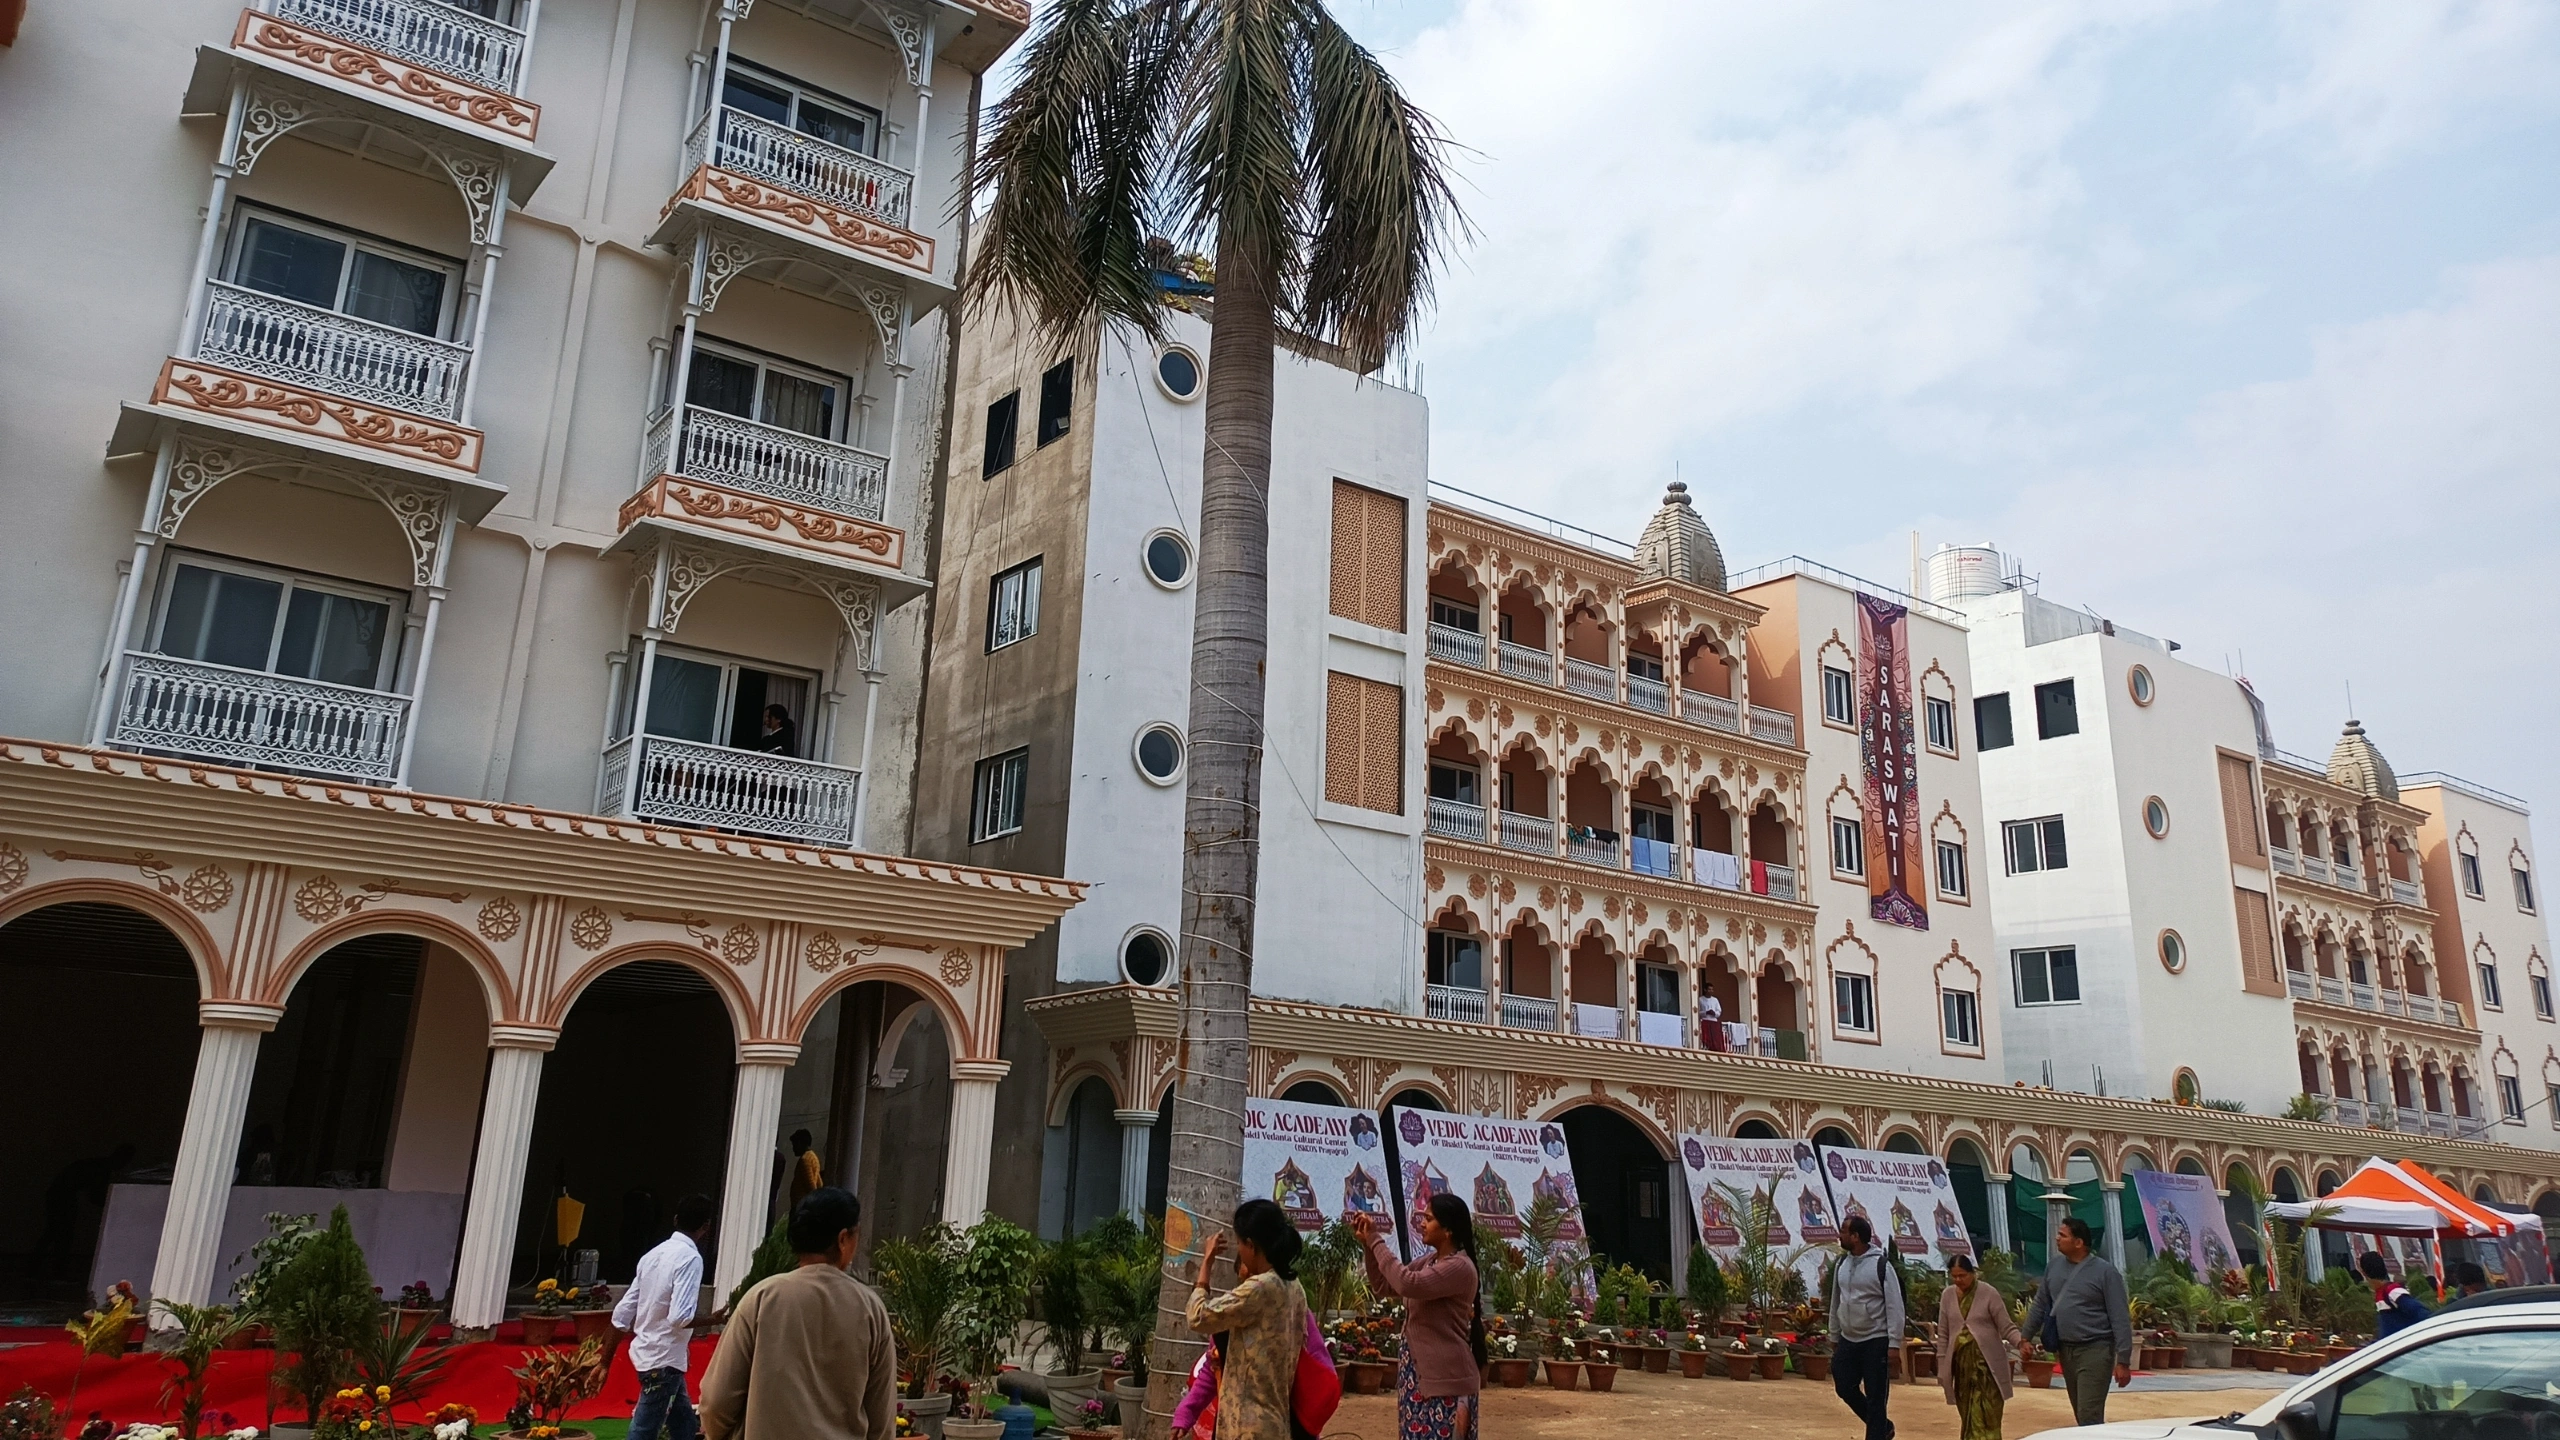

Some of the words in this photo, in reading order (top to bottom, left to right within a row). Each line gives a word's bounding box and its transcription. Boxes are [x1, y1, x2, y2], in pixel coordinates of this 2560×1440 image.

[1879, 666, 1899, 876] SARASWATI
[1245, 1109, 1267, 1129] DIC
[1273, 1112, 1347, 1137] ACADEMY
[1426, 1119, 1468, 1140] VEDIC
[1473, 1123, 1538, 1146] ACADEMY
[1262, 1131, 1292, 1142] Vedanta
[1293, 1134, 1323, 1145] Cultural
[1324, 1137, 1347, 1147] Center
[1441, 1140, 1463, 1149] Bhakti
[1464, 1141, 1491, 1151] Vedanta
[1491, 1144, 1517, 1154] Cultural
[1518, 1146, 1538, 1155] Center
[1704, 1145, 1737, 1162] VEDIC
[1740, 1147, 1793, 1164] ACADEMY
[1757, 1164, 1777, 1172] Cultural
[1845, 1158, 1877, 1175] VEDIC
[1880, 1161, 1928, 1179] ACADEMY
